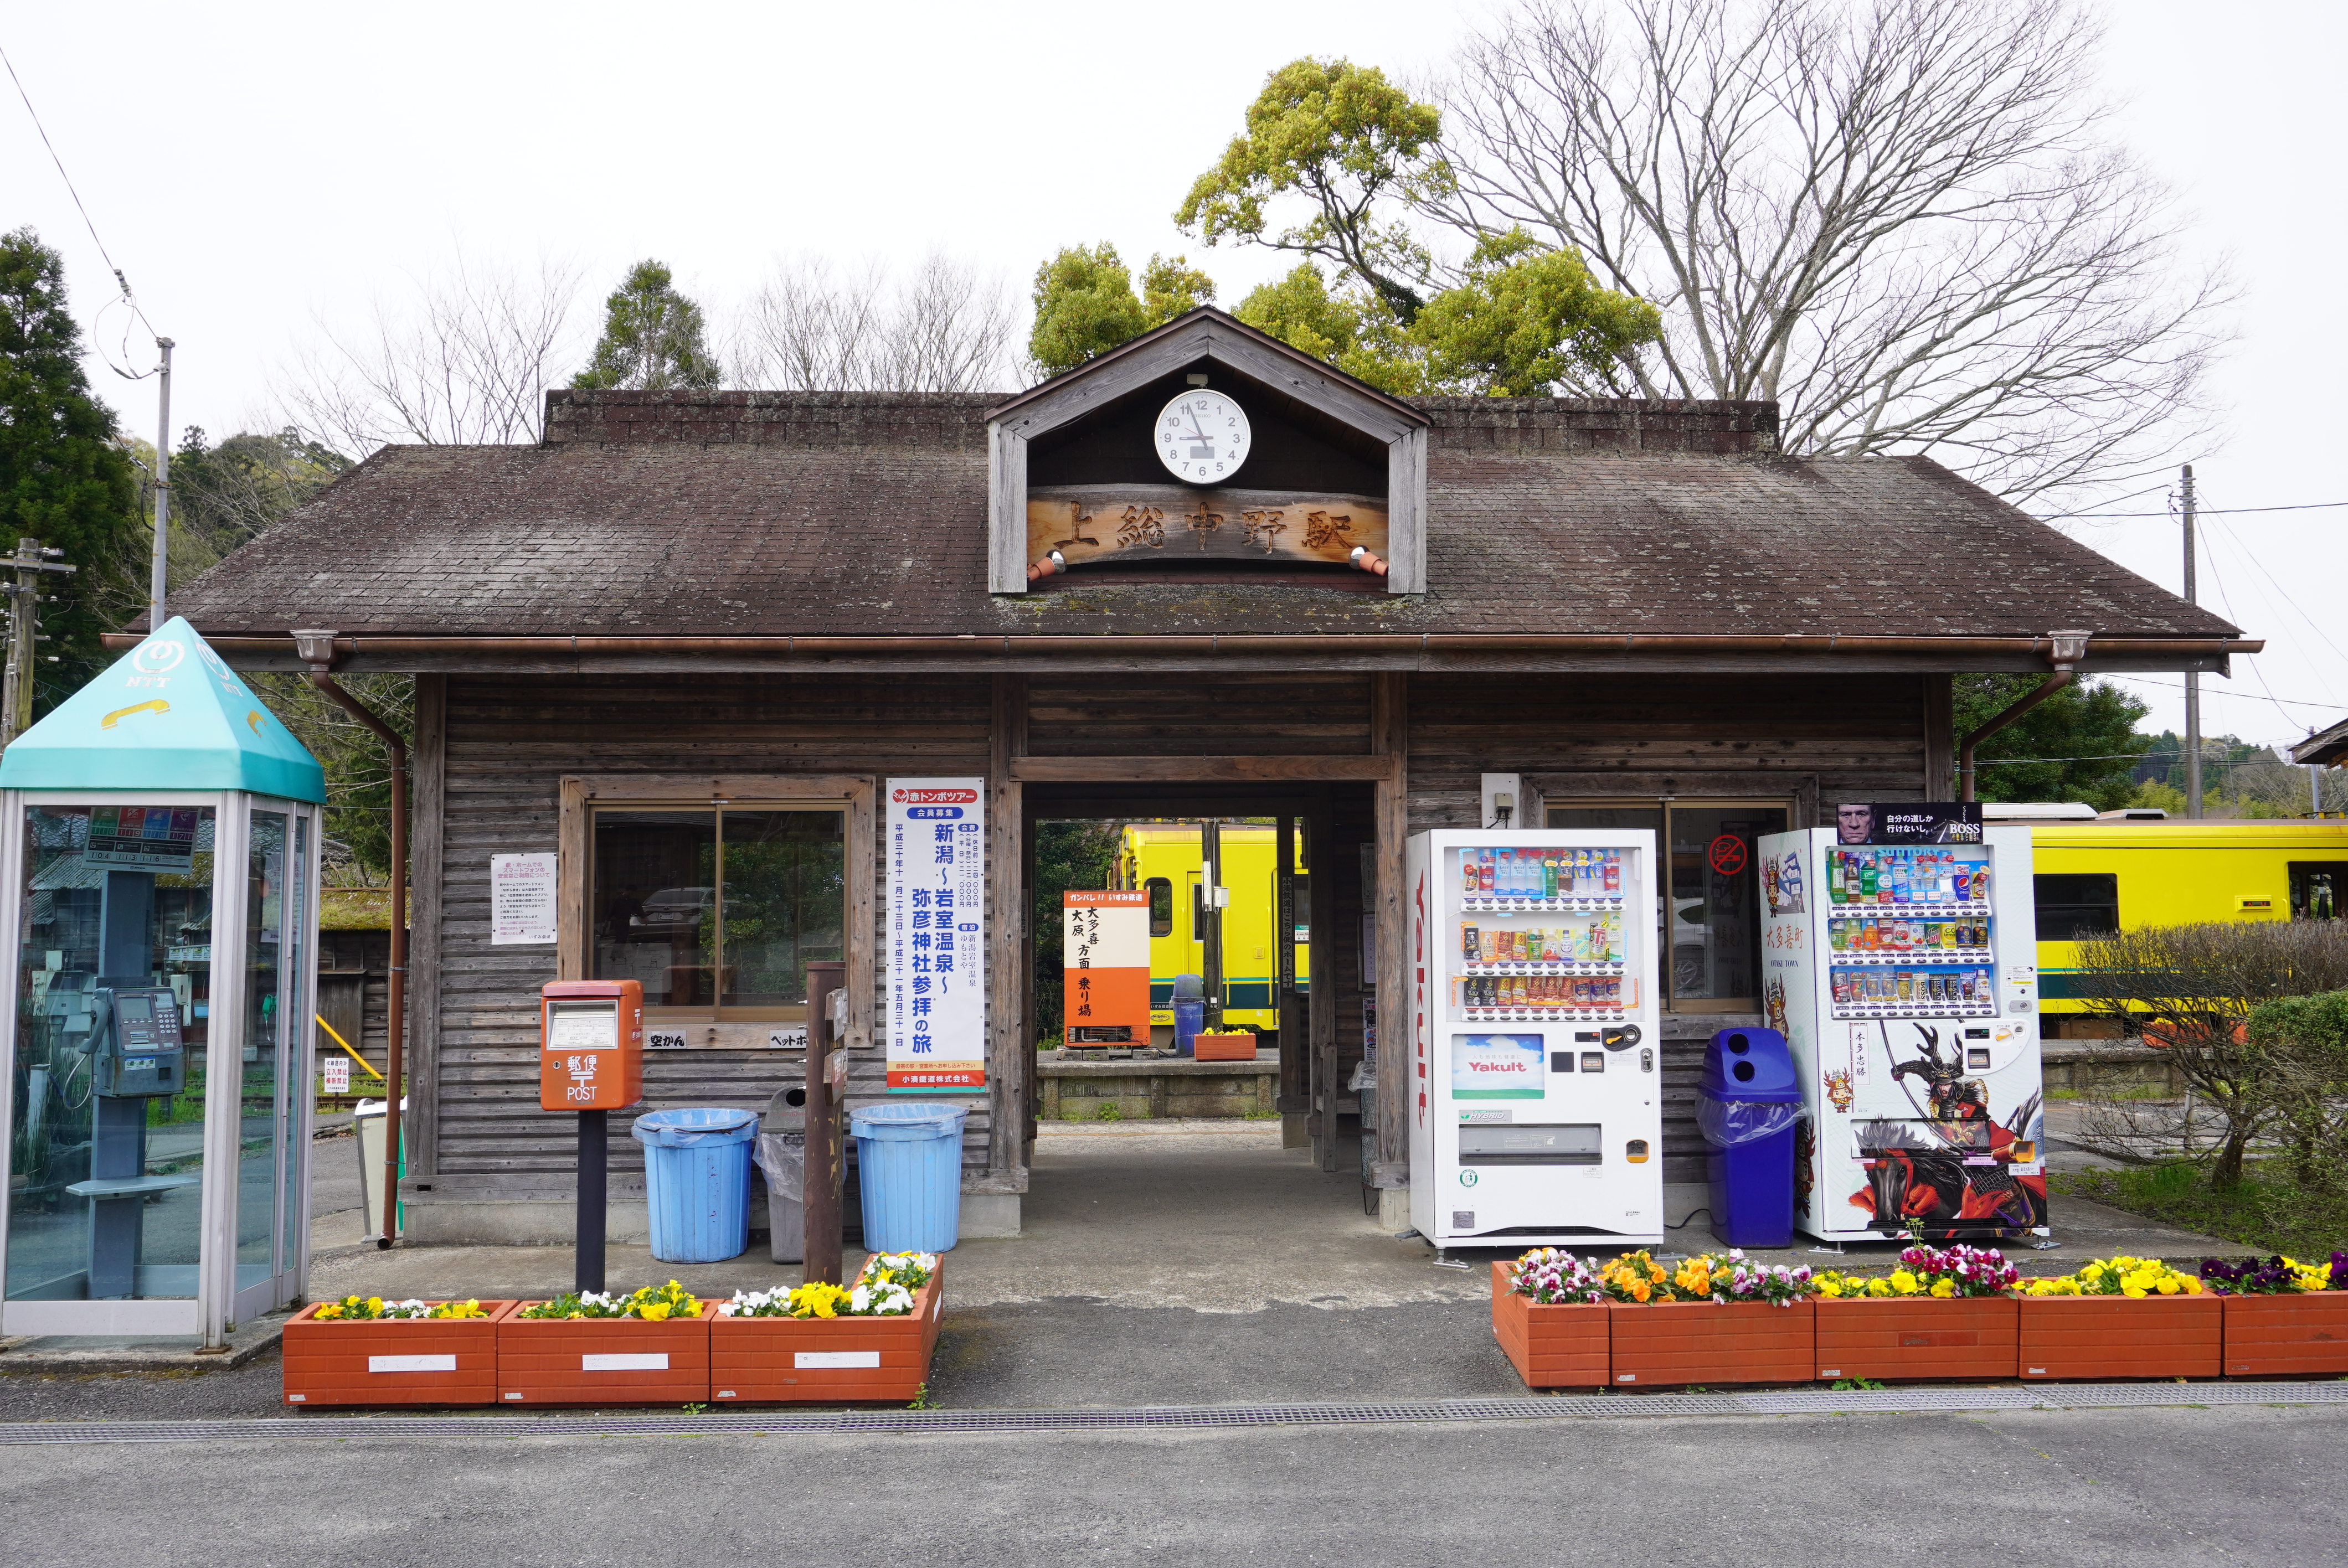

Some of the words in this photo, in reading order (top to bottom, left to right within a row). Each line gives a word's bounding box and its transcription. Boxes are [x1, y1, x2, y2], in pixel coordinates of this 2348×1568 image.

[1180, 405, 1190, 415] 11
[1196, 400, 1207, 410] 12
[1217, 405, 1221, 415] 1
[1167, 417, 1180, 427] 10
[1228, 417, 1235, 427] 2
[1164, 433, 1172, 443] 9
[1233, 434, 1240, 443] 3
[1170, 450, 1177, 459] 8
[1228, 450, 1236, 460] 4
[1182, 462, 1190, 471] 7
[1199, 466, 1206, 476] 6
[1216, 462, 1223, 472] 5
[1053, 500, 1355, 554] 上総中野駅
[125, 677, 171, 688] NTT
[219, 681, 244, 697] NTT
[910, 792, 975, 802] 赤トンボツアー
[917, 809, 954, 817] 会員募集
[1887, 814, 1933, 823] 自分の道しか
[1887, 824, 1929, 833] 行けないし。
[1949, 823, 1980, 834] BOSS
[1518, 848, 1568, 857] Yakult
[1109, 893, 1143, 902] いすみ鉄道
[1072, 910, 1084, 937] 大原
[1087, 906, 1100, 945] 大多喜
[1283, 877, 1293, 988] 小湊鉄道はこちら側のホームです
[1533, 943, 1539, 956] お茶
[1078, 945, 1090, 970] 方面
[912, 888, 932, 1054] 弥彦神社参拝の旅
[1078, 977, 1092, 1017] 乗り場
[1415, 865, 1427, 1131] Yakult
[651, 1035, 685, 1048] 空かん
[1856, 1031, 1867, 1076] 本多忠勝
[567, 1055, 598, 1072] 郵便
[1468, 1061, 1527, 1072] Yakult
[902, 1075, 969, 1083] 小湊鐵道株式会社
[567, 1086, 598, 1101] POST
